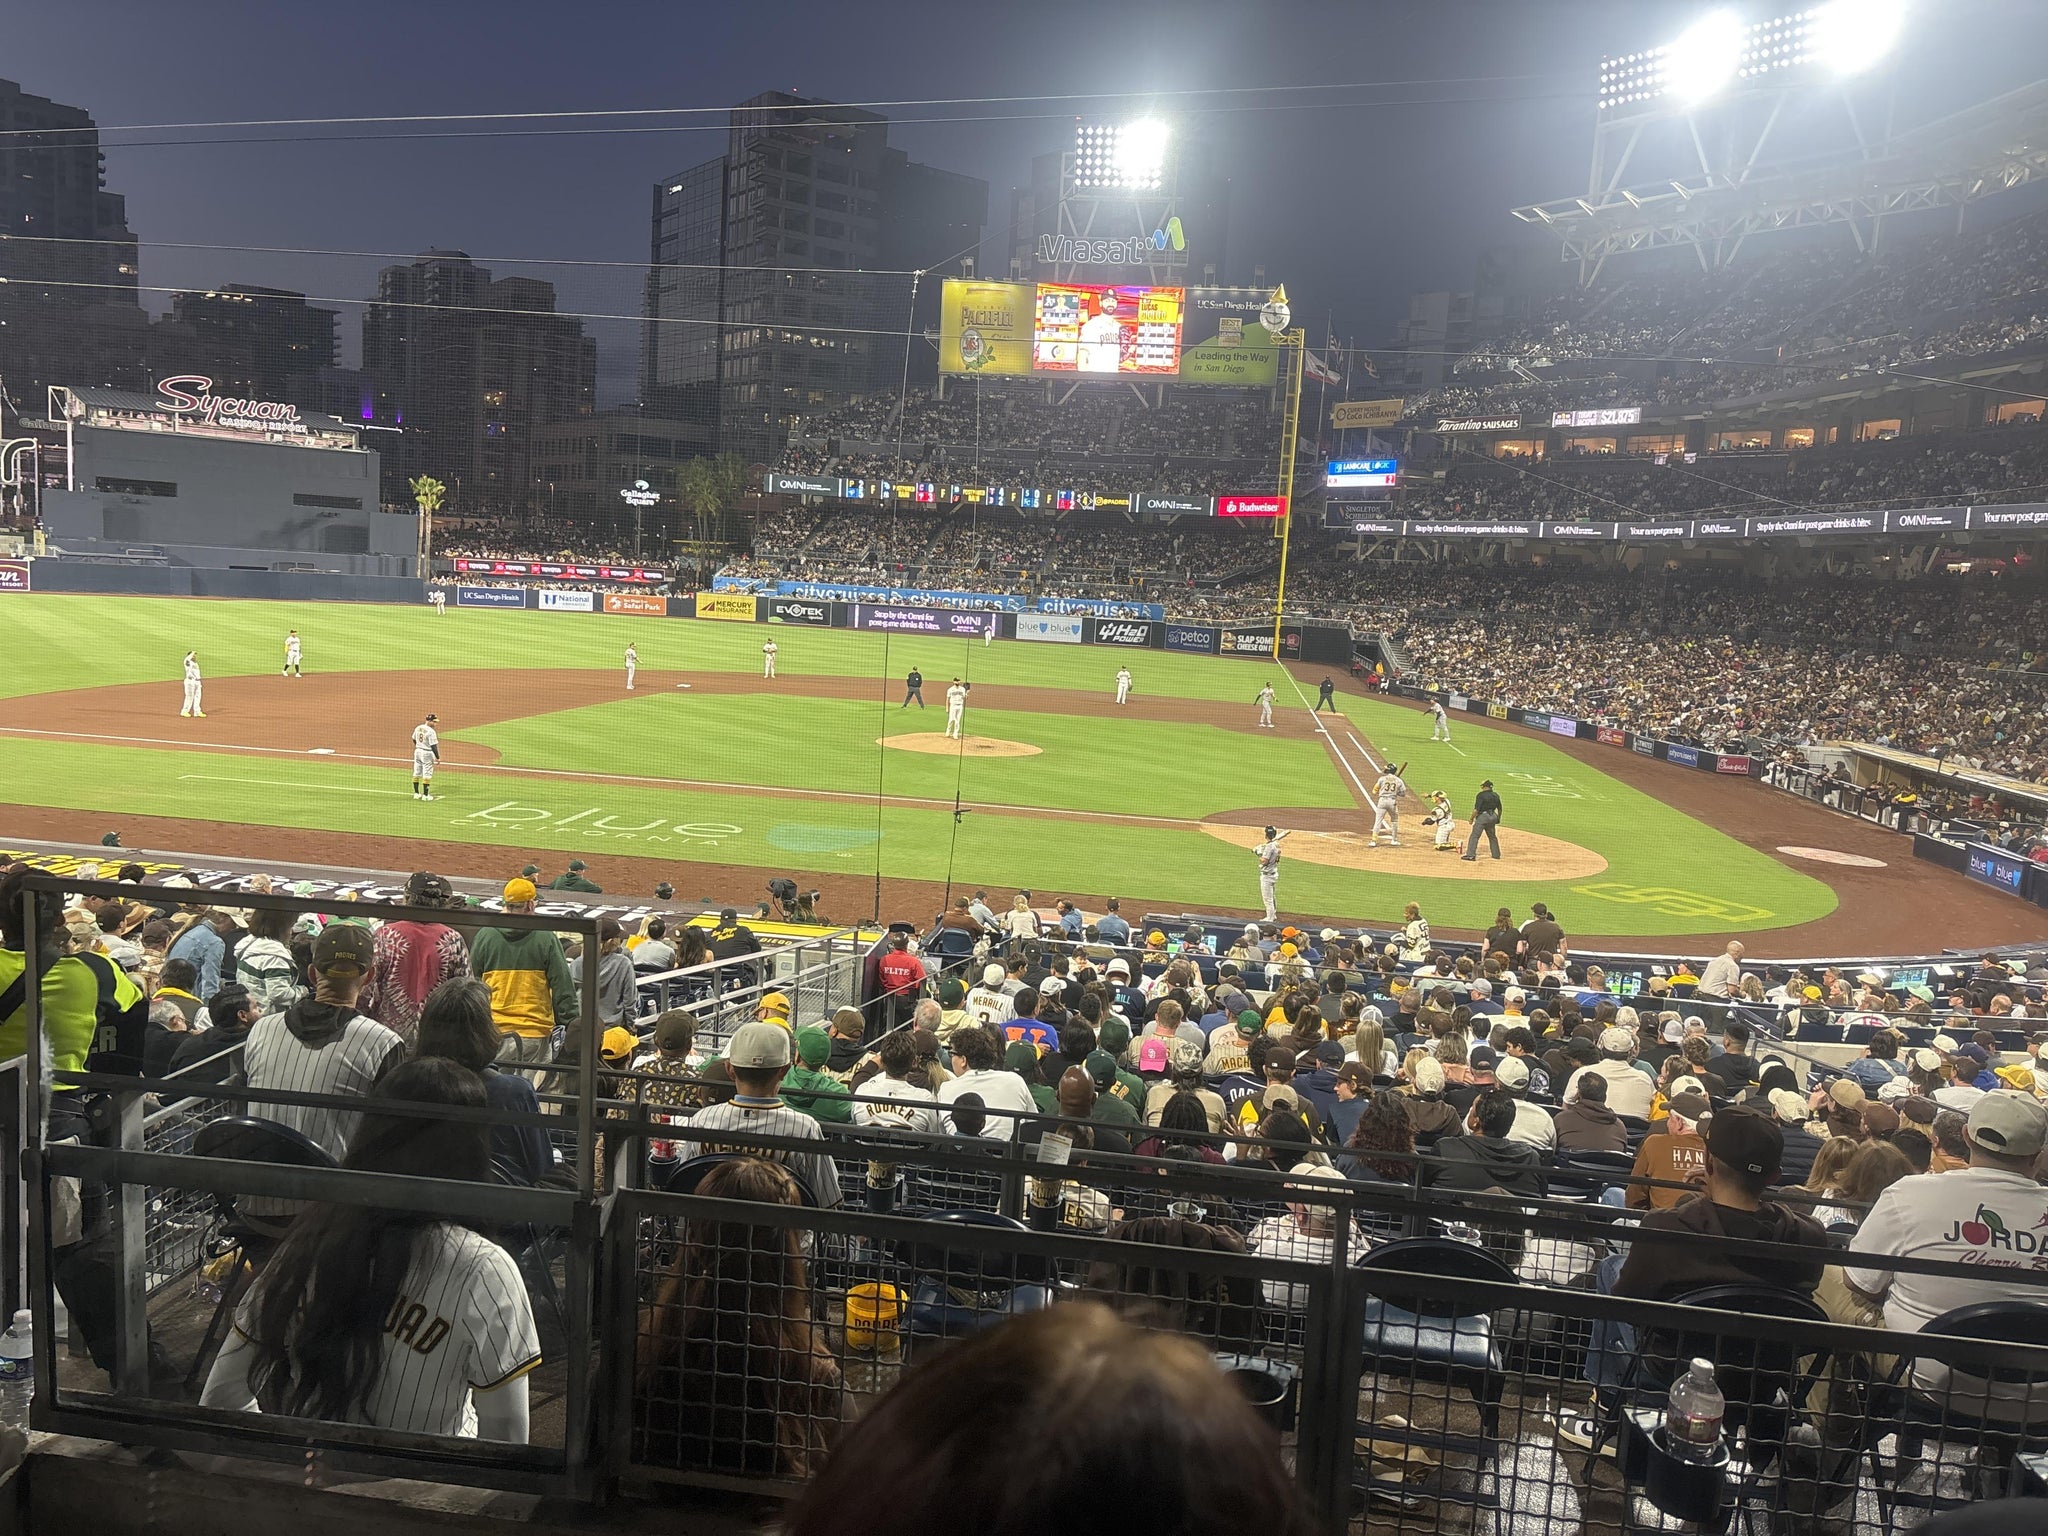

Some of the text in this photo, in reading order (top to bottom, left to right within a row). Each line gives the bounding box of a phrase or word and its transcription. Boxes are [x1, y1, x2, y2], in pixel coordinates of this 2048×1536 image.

[1042, 233, 1142, 264] Viasat
[1198, 300, 1245, 311] UC San Diego
[1195, 351, 1269, 363] Leading the Way
[1194, 364, 1245, 374] in San Diego
[156, 375, 301, 424] Sycuan
[1363, 410, 1397, 419] ICHIBANYA
[1600, 409, 1635, 424] $21,875
[219, 416, 308, 434] CASINO RESORT
[1438, 419, 1518, 431] Tarantino SAUSAGES
[780, 479, 807, 490] OMNI
[620, 489, 660, 499] Gallagher
[626, 497, 655, 506] Square
[1148, 500, 1176, 510] OMNI
[1239, 501, 1280, 512] Budweiser
[1899, 515, 1927, 526] OMNI
[1984, 512, 2034, 524] Your new post
[1356, 523, 1377, 531] OMNI
[1554, 525, 1578, 534] OMNI
[1701, 524, 1720, 533] OMNI
[485, 593, 501, 601] Diego
[559, 595, 590, 603] National
[716, 600, 752, 608] MERCURY
[776, 604, 823, 617] EVOTEK
[874, 610, 935, 621] Stop by the Omni for
[900, 620, 917, 629] drinks
[918, 621, 924, 629] &
[951, 615, 981, 626] OMNI
[1019, 622, 1071, 632] blue blue
[1115, 624, 1149, 636] H2O
[1181, 630, 1210, 643] petco
[1237, 635, 1255, 644] SLAP
[1237, 643, 1258, 651] CHEESE
[418, 733, 424, 743] 8
[1384, 782, 1397, 792] 33
[466, 801, 744, 838] blue
[449, 818, 719, 847] CALIFORNIA
[1970, 855, 1987, 871] blue
[1996, 864, 2013, 881] blue
[335, 951, 356, 961] PADRES
[883, 966, 910, 976] ELITE
[973, 995, 1002, 1012] MERRILL
[1673, 1149, 1704, 1163] HAN
